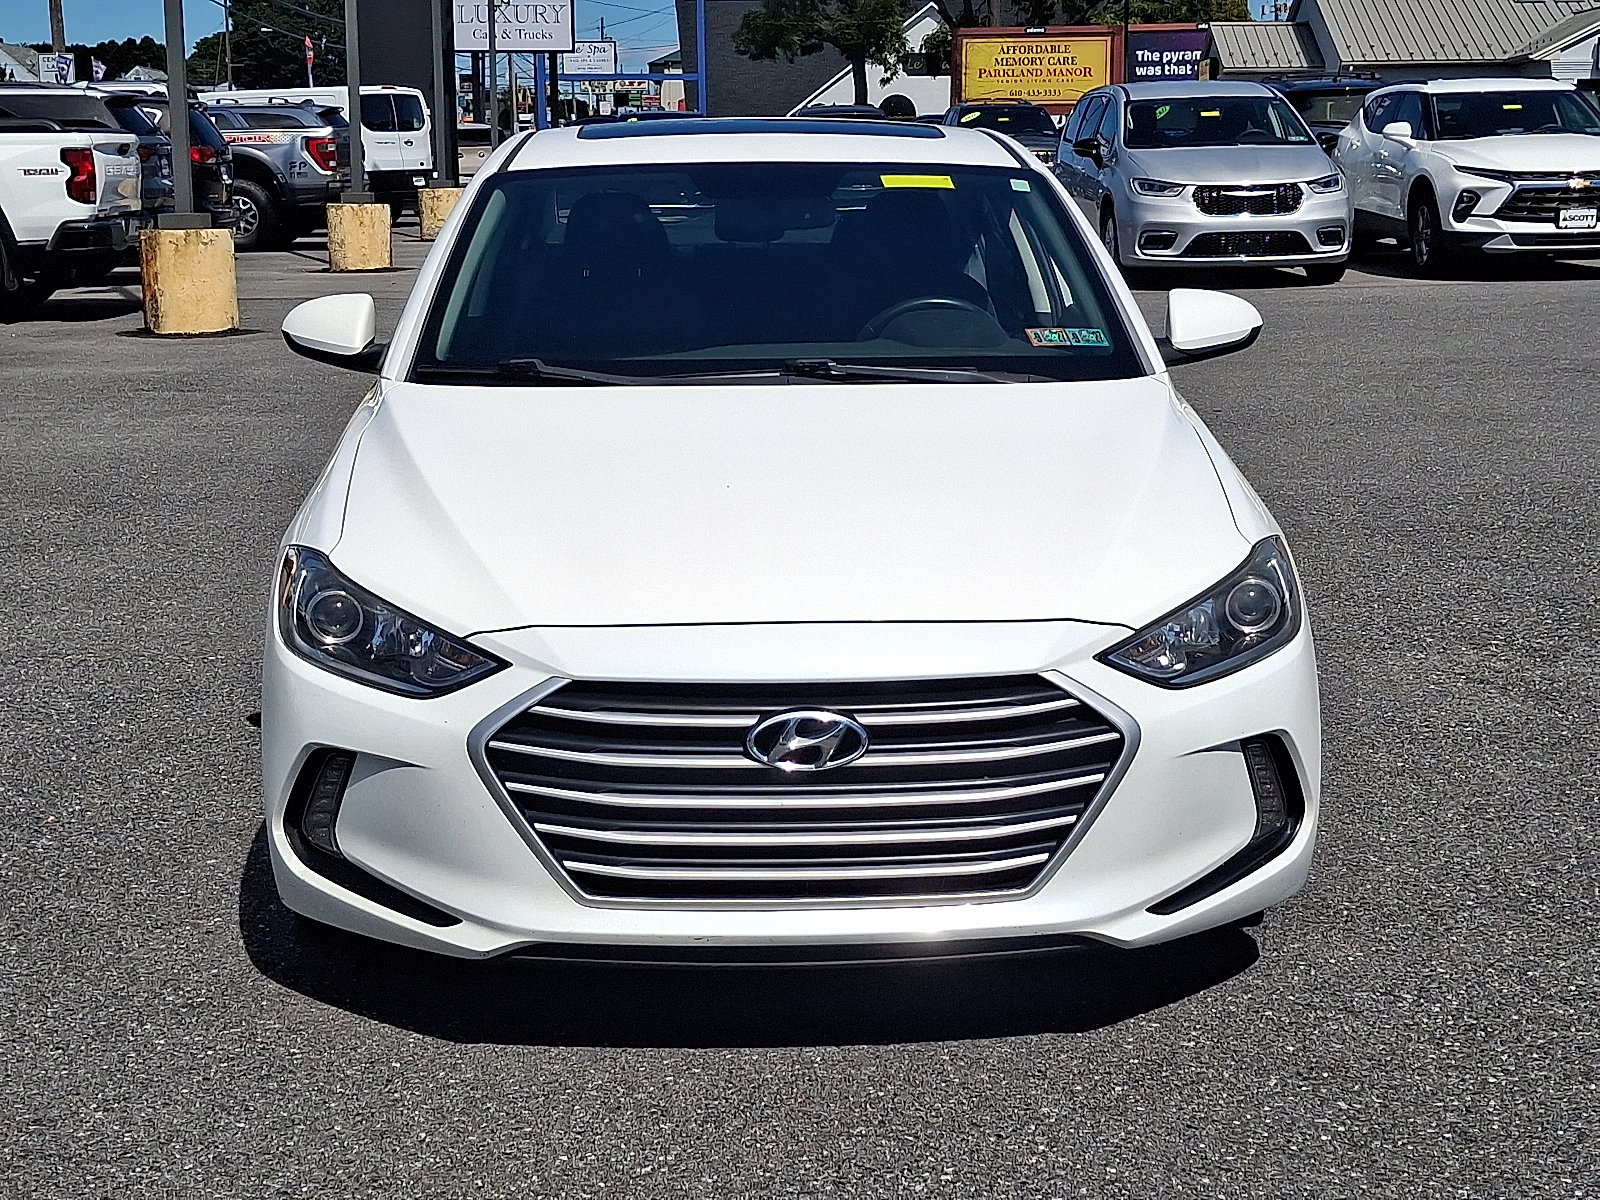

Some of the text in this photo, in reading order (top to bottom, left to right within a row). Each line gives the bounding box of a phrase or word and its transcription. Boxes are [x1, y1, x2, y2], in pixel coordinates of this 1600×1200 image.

[457, 4, 566, 24] LUXURY
[501, 28, 512, 40] &
[515, 28, 554, 40] Trucks
[587, 43, 609, 56] Spa
[998, 44, 1072, 55] AFFORDABLE
[1135, 49, 1161, 62] The
[993, 56, 1078, 67] MEMORY CARE
[977, 66, 1094, 79] PARKLAND MANOR
[1135, 63, 1193, 76] was that
